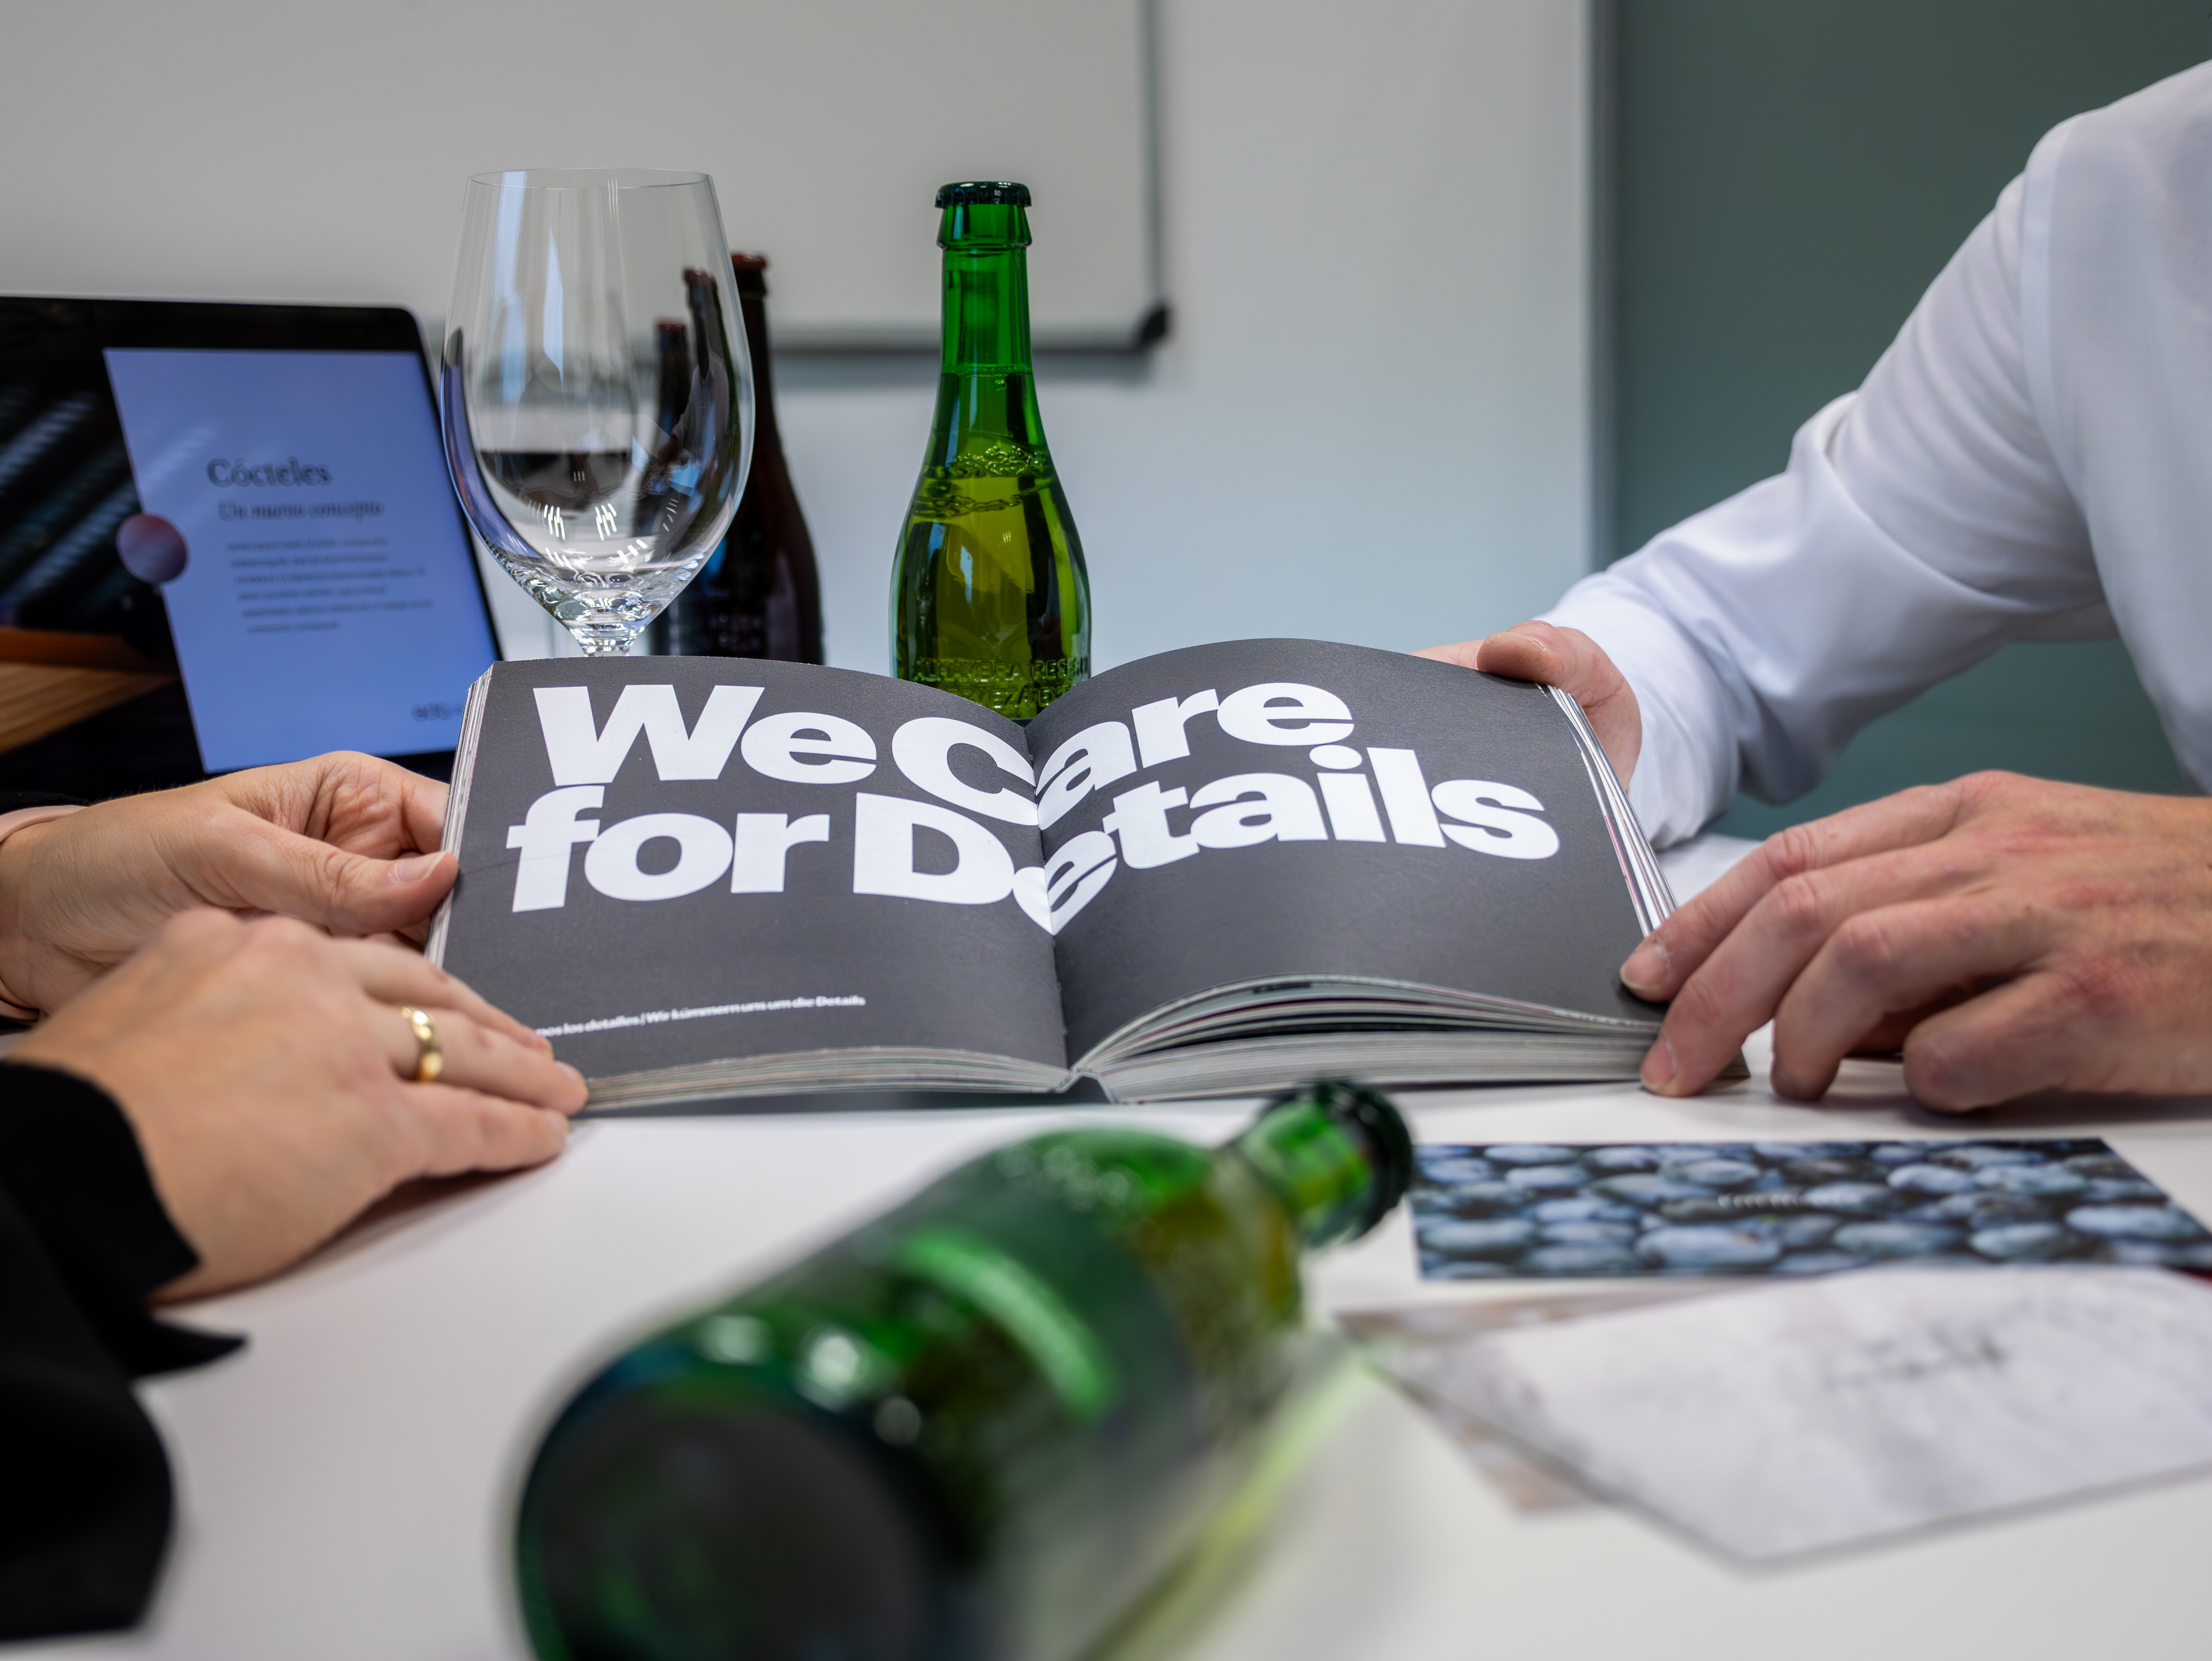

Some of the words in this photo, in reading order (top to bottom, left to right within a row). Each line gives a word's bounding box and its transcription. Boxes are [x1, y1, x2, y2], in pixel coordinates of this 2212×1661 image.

[207, 456, 332, 487] Cócteles
[533, 684, 877, 786] We
[892, 682, 1355, 830] Care
[506, 785, 830, 912] for
[853, 744, 1560, 935] Details
[815, 995, 867, 1007] Details
